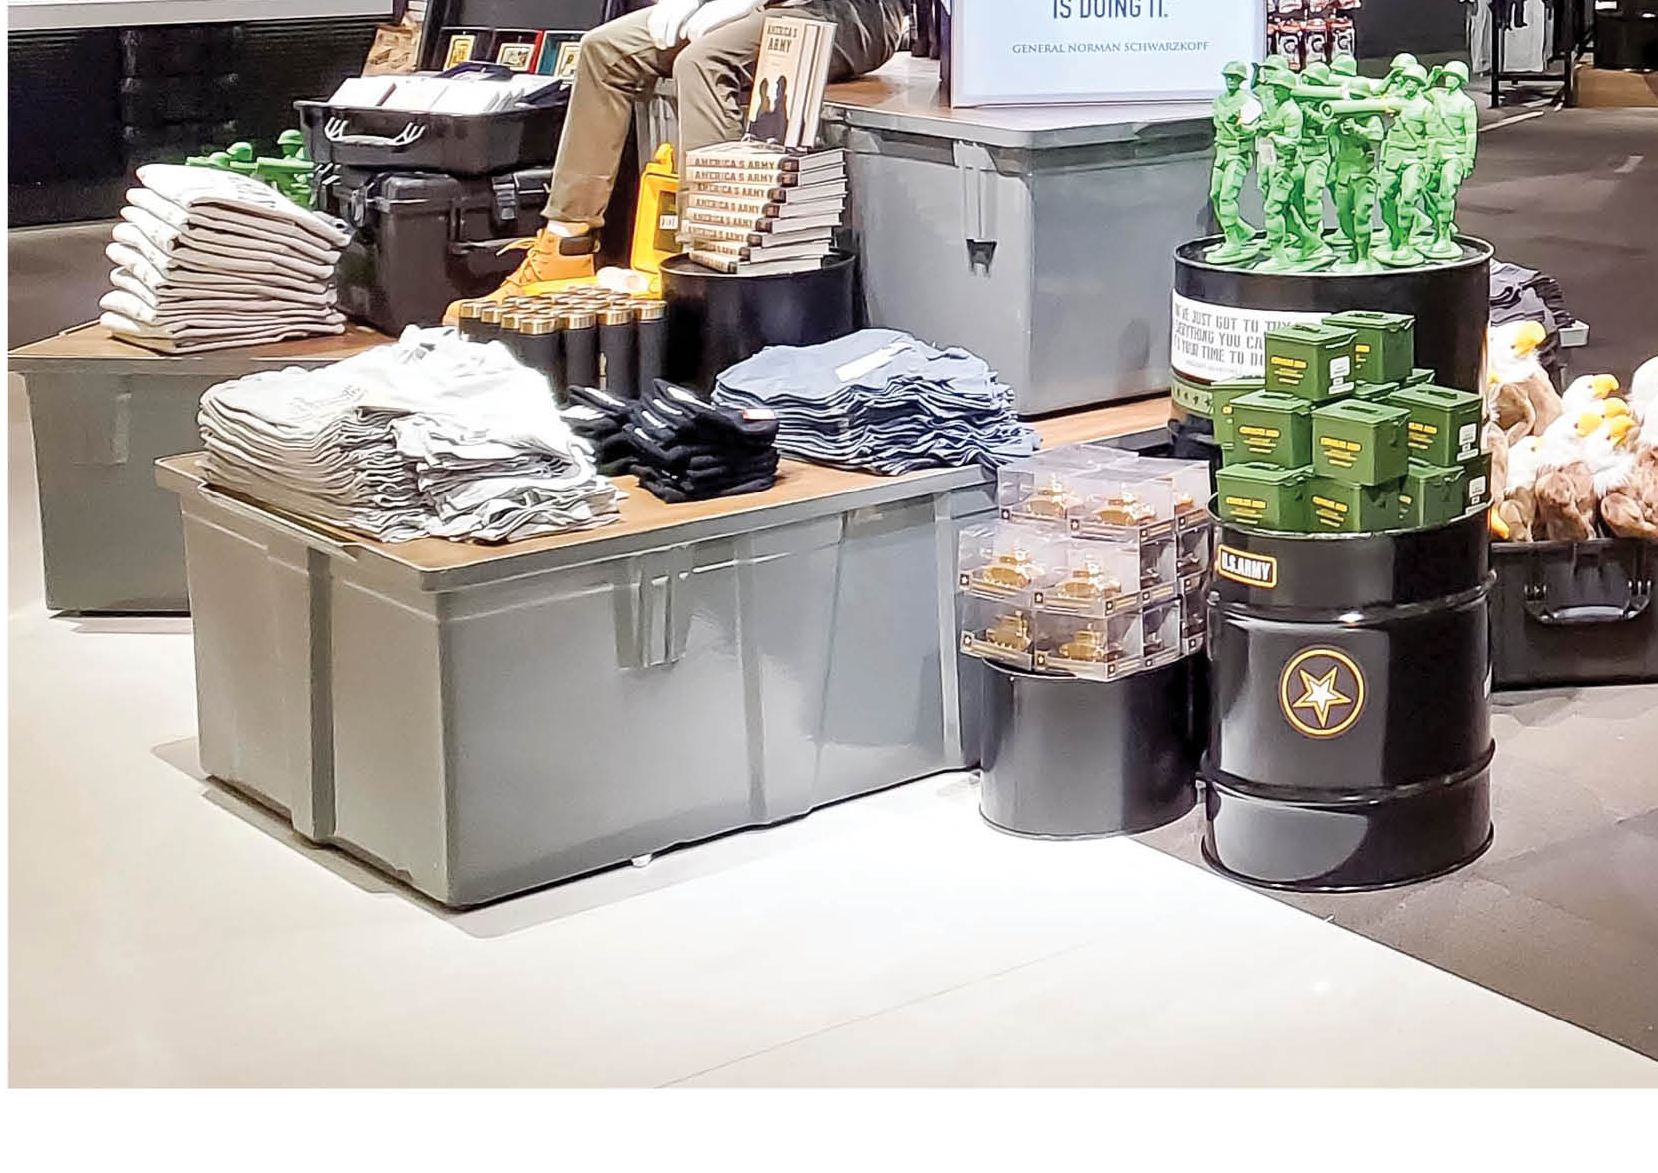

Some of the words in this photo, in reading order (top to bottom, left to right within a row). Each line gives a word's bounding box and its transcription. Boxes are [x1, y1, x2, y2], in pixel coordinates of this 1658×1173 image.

[767, 37, 792, 54] ARMY
[1012, 44, 1065, 54] GENERAL
[1068, 42, 1121, 53] NORMAN
[1124, 41, 1210, 53] SCHWARZKOPF
[748, 160, 774, 170] ARMY
[747, 173, 774, 182] ARMY
[742, 188, 764, 198] ARMY
[1216, 315, 1238, 331] GOT
[1243, 318, 1259, 333] TO
[1219, 331, 1241, 348] YOU
[1246, 335, 1263, 350] CA
[1201, 345, 1225, 363] TIME
[1230, 350, 1244, 365] TO
